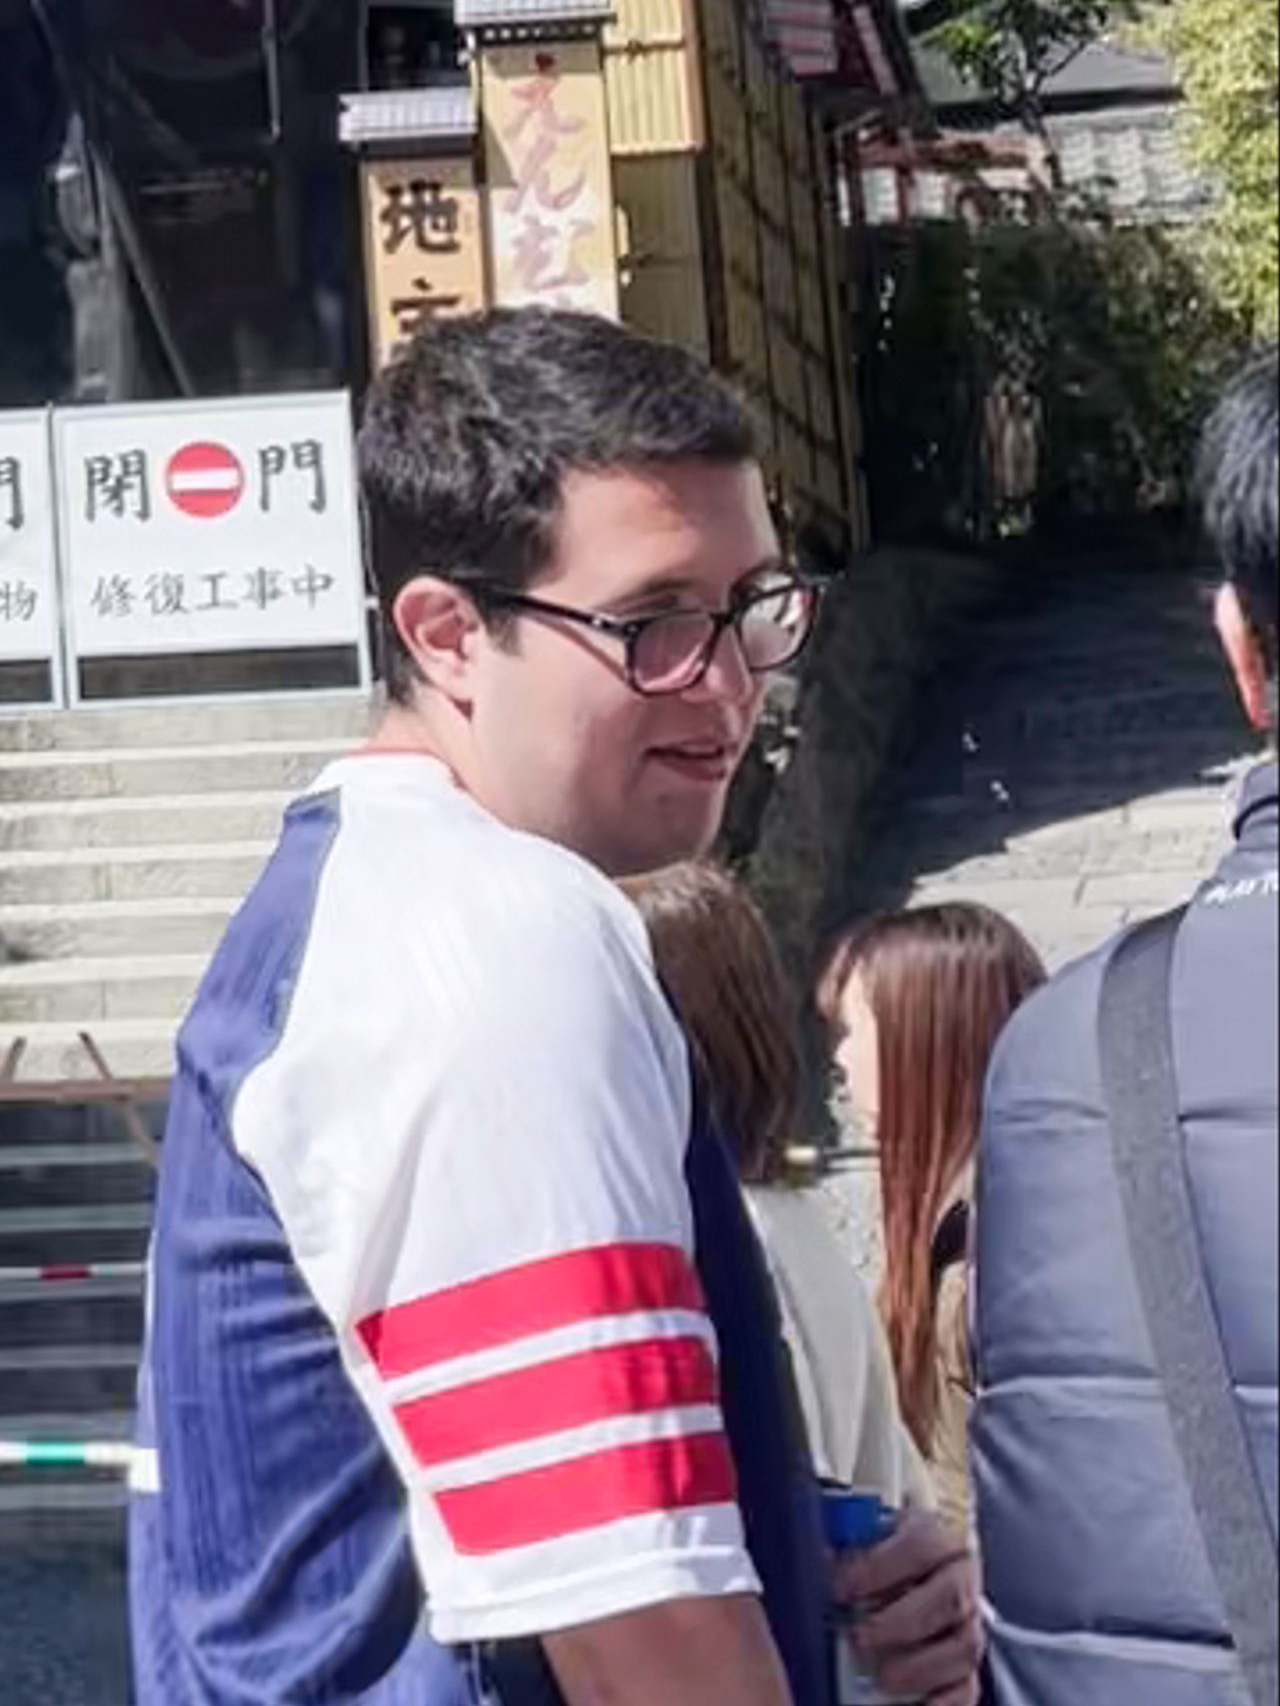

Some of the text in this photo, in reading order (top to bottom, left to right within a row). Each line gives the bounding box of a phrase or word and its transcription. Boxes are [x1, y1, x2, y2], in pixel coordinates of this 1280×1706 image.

[85, 439, 327, 523] 閉 門
[90, 563, 335, 618] 修復工事中
